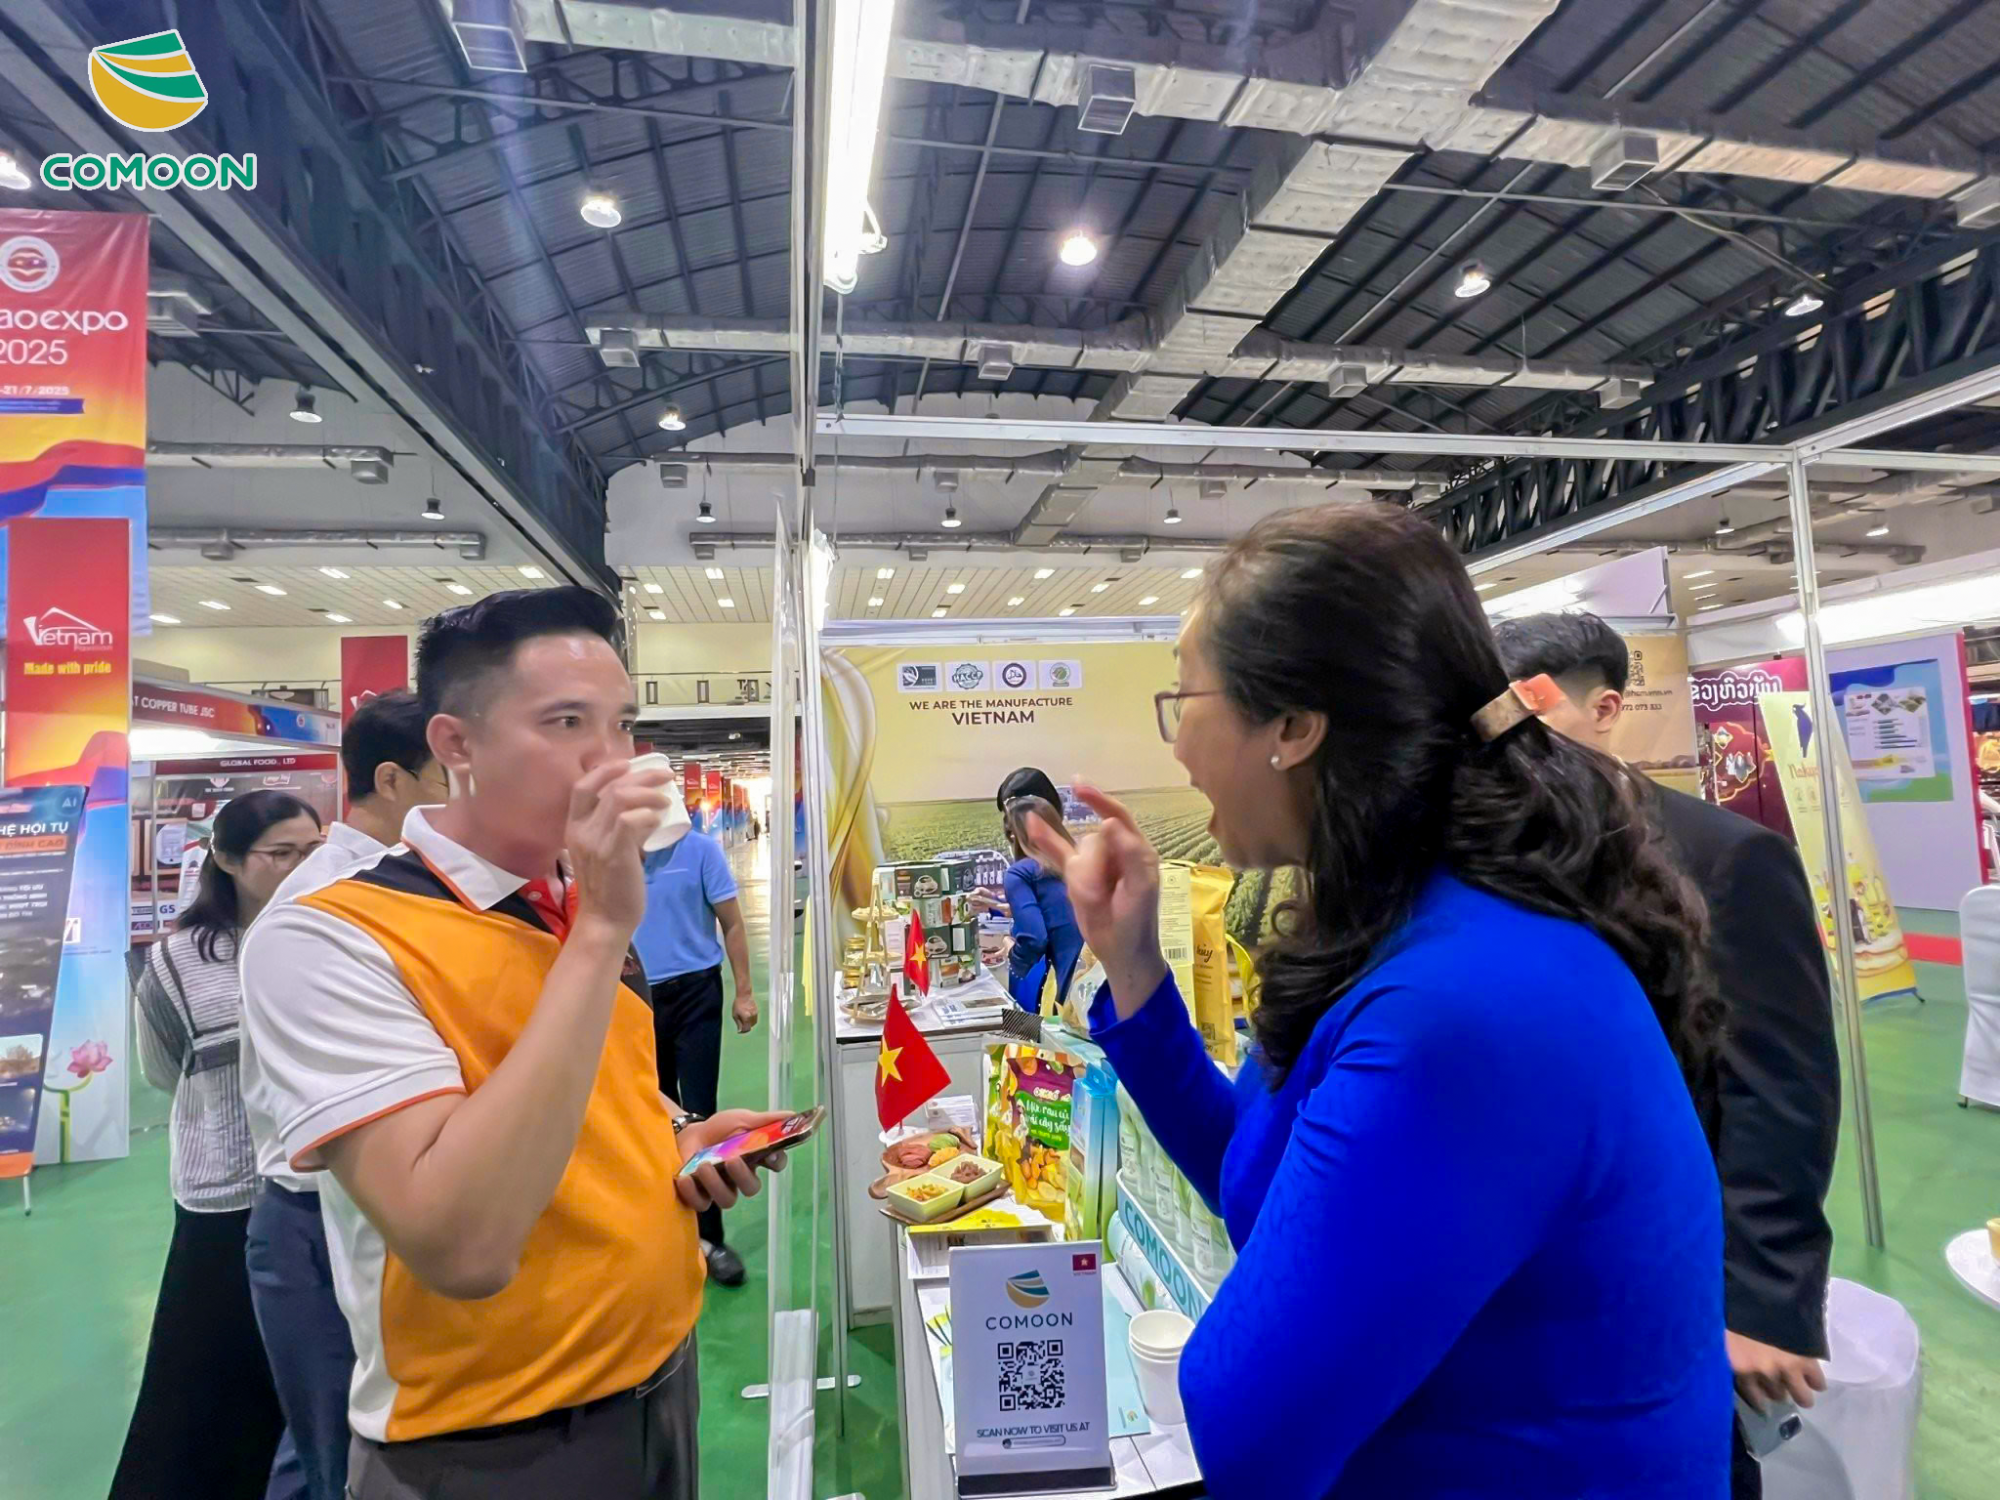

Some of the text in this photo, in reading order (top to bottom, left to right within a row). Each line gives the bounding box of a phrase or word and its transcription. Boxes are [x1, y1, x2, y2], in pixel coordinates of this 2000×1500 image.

[24, 661, 112, 675] Made with pride
[141, 697, 178, 713] COPPER
[179, 702, 199, 716] TUBE
[200, 706, 215, 718] JSC
[909, 697, 1073, 710] WE ARE THE MANUFACTURE
[952, 711, 1034, 725] VIETNAM
[220, 759, 252, 767] GLOBAL
[283, 757, 296, 765] LTD
[20, 823, 45, 836] HỘI
[50, 821, 69, 834] TỤ
[985, 1312, 1074, 1331] COMOON
[976, 1422, 1091, 1438] SCAN NOW TO VISIT US AT
